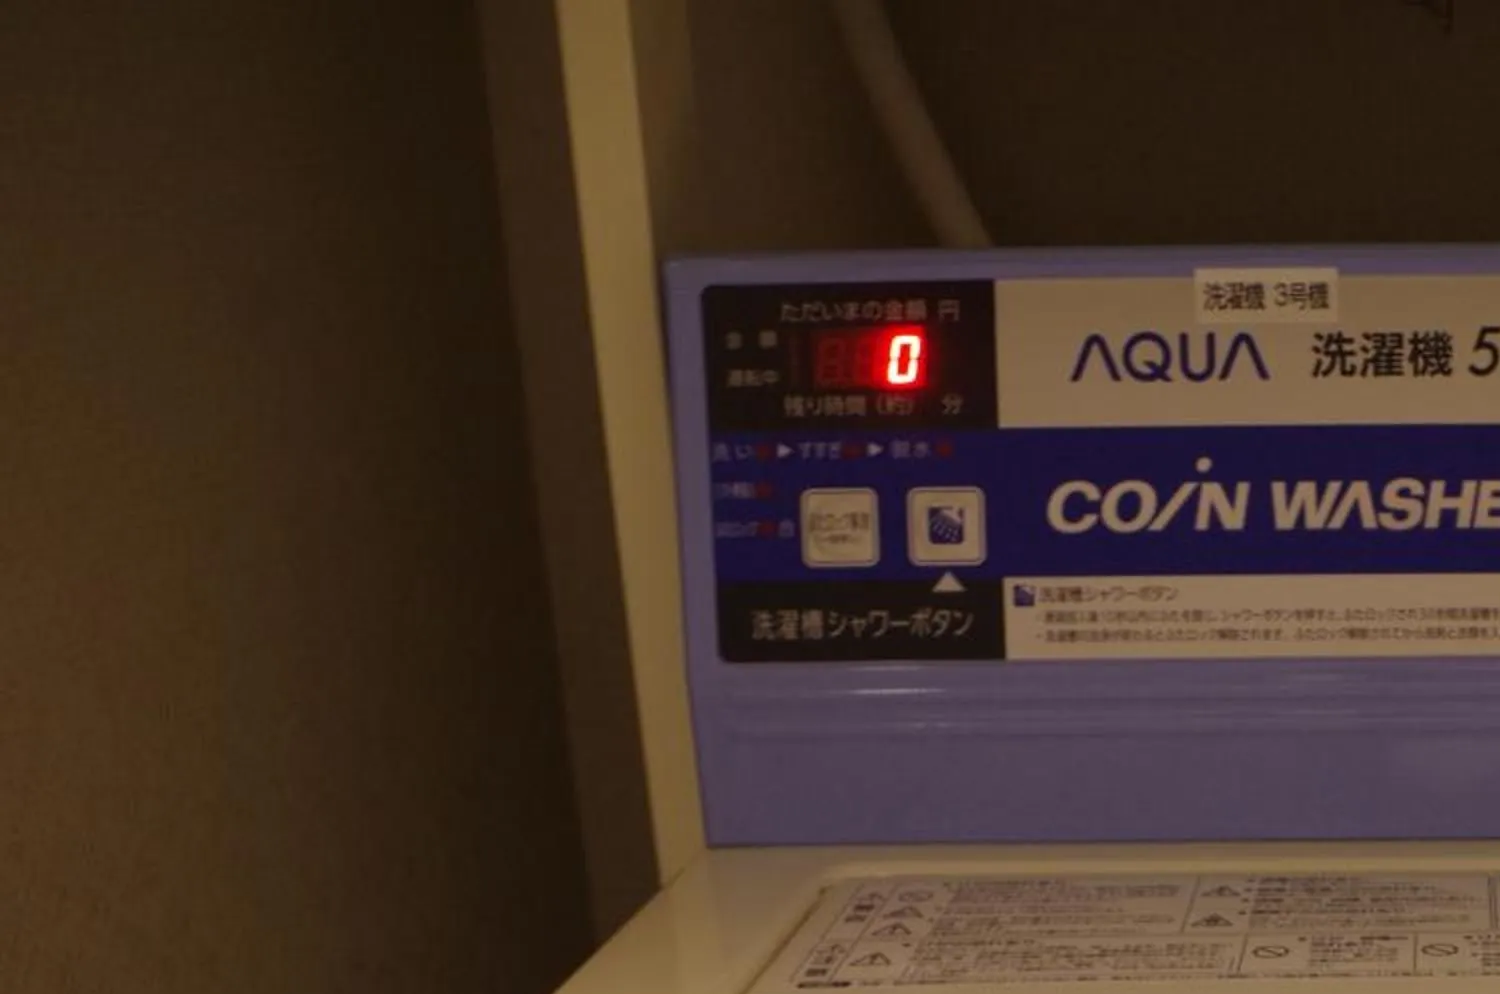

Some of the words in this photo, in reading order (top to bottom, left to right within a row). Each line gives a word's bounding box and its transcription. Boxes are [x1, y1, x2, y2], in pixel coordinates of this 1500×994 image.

[1203, 282, 1267, 311] 洗濯機
[1273, 282, 1330, 311] 3号機
[886, 334, 922, 385] 0
[1071, 332, 1271, 382] AQUA
[1311, 331, 1454, 379] 洗濯機
[1046, 457, 1250, 534] COIN
